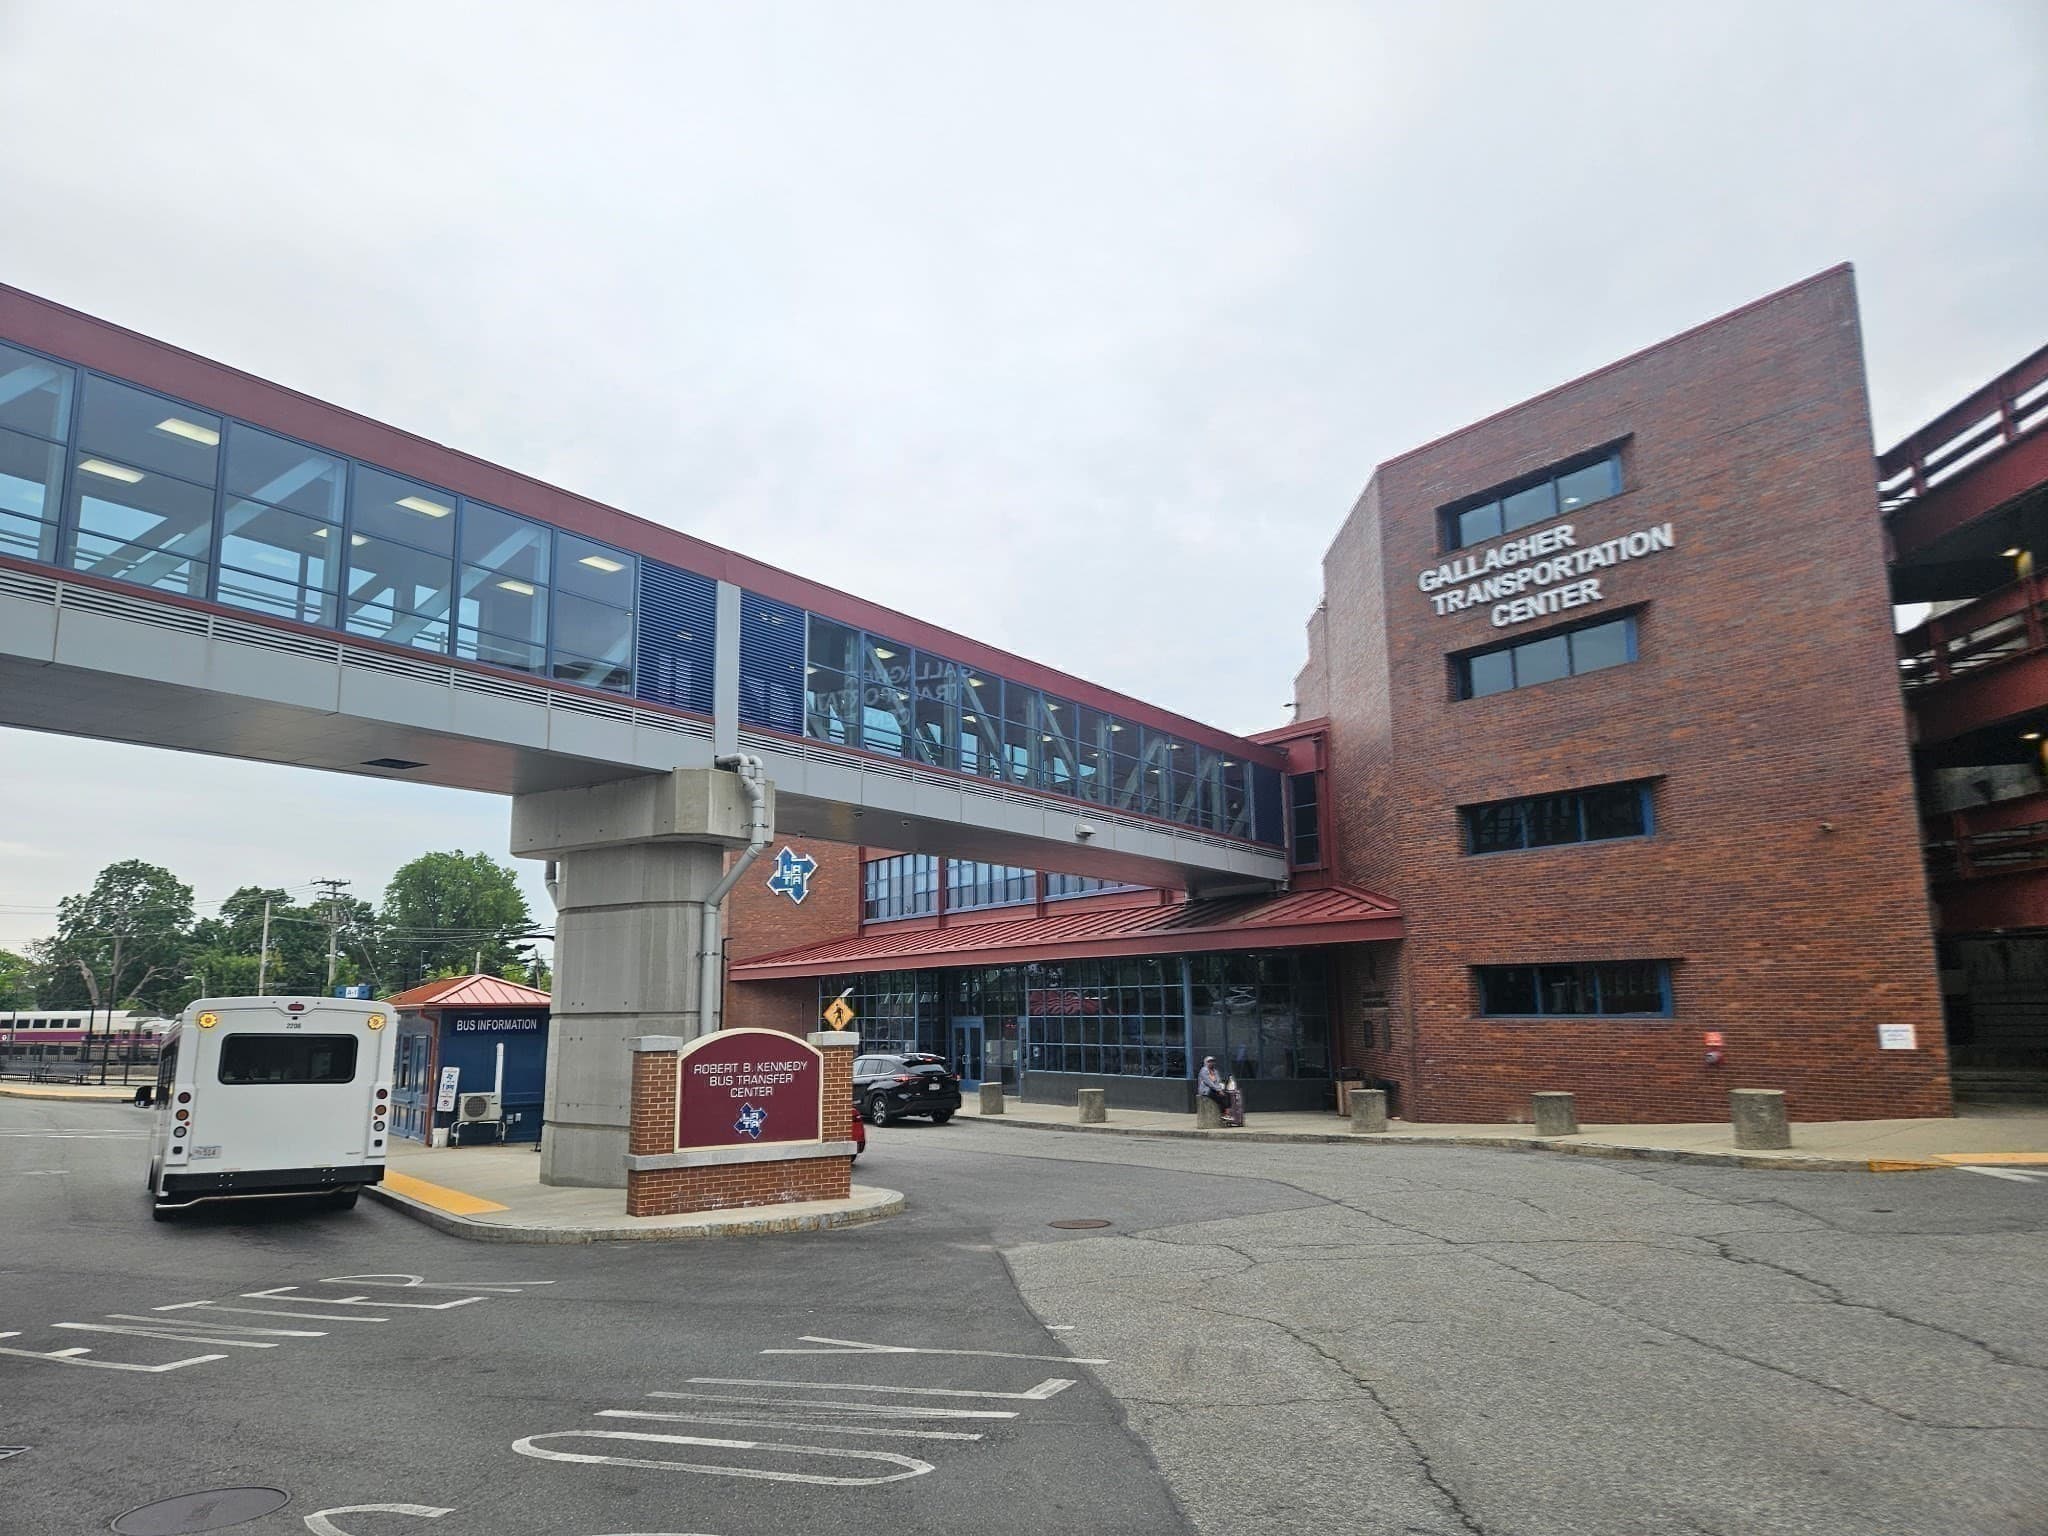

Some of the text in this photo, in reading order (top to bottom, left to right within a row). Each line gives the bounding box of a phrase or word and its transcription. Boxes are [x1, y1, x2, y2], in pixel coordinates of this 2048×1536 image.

[1418, 524, 1576, 592] GALLAGHER
[1430, 523, 1674, 616] TRANSPORTATION
[1491, 578, 1603, 627] CENTER
[456, 1019, 537, 1031] BUS INFORMATION
[693, 1061, 807, 1074] ROBERT B. KENNEDY
[709, 1073, 793, 1087] BUS TRANSFER
[730, 1086, 773, 1098] CENTER
[512, 1335, 1112, 1487] ONLY
